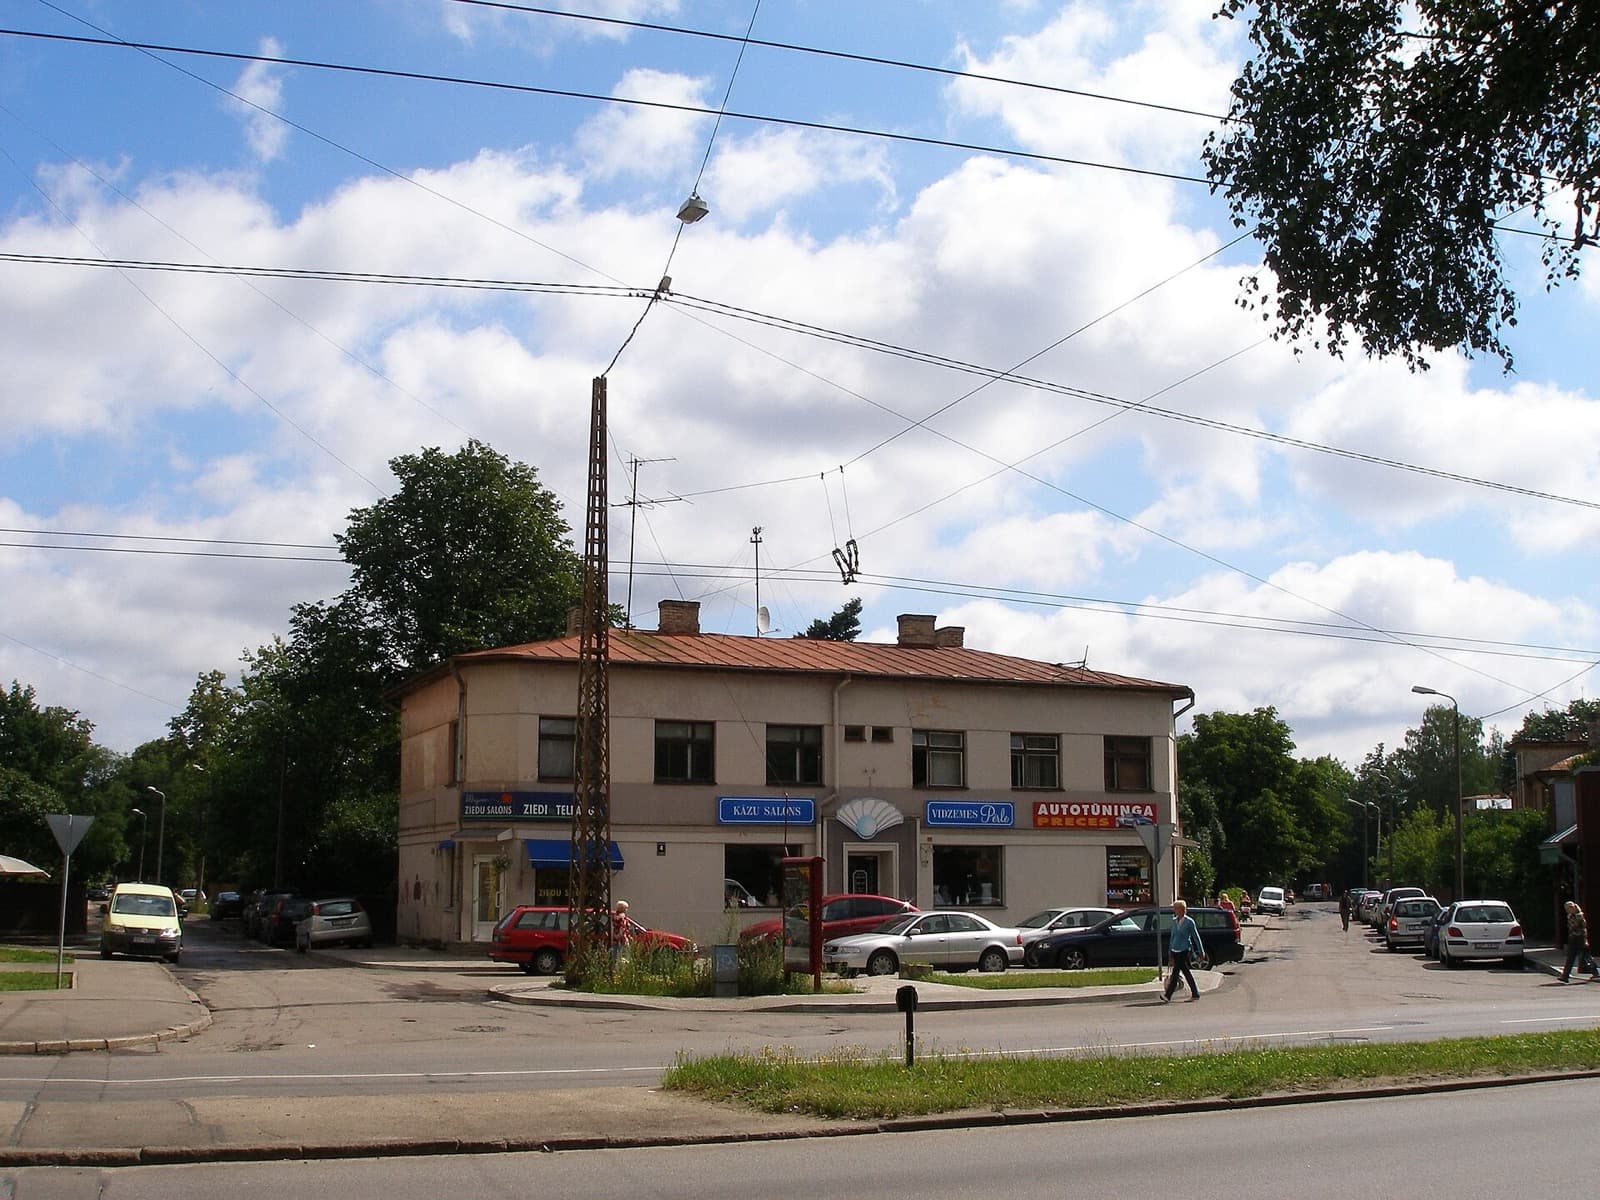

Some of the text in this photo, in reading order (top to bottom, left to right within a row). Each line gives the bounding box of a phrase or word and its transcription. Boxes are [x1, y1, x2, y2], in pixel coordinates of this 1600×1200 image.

[464, 805, 513, 815] ZIEDU SALONS
[523, 804, 548, 815] ZIEDI
[763, 806, 801, 817] SALONS
[932, 808, 979, 819] VIDZEMES
[1037, 817, 1110, 827] PRECES
